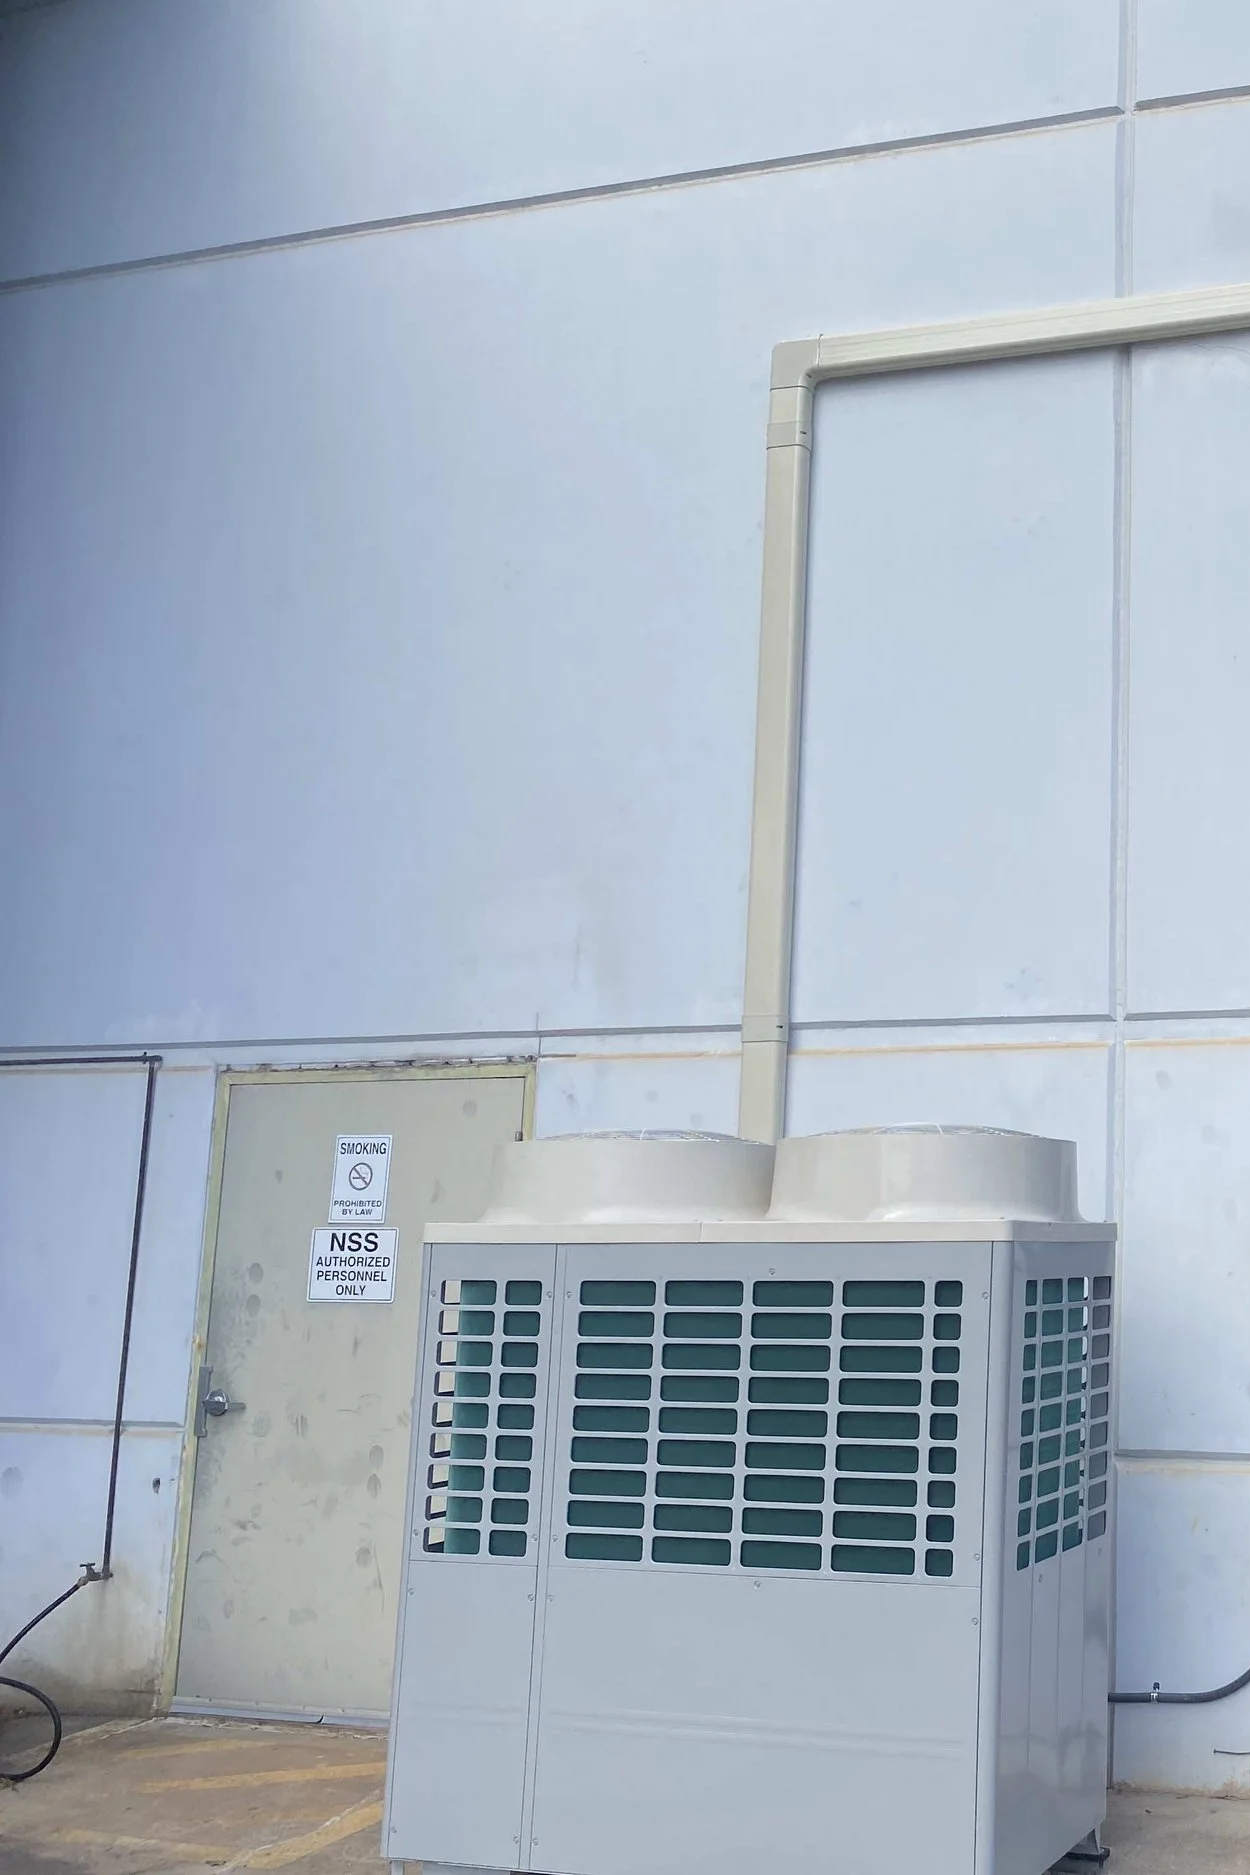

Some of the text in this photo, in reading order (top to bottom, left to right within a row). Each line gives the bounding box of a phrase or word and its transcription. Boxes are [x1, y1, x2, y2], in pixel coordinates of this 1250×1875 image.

[340, 1142, 387, 1155] SMOKING
[333, 1200, 382, 1208] PROHIBITED
[330, 1232, 379, 1252] NSS
[316, 1256, 391, 1268] AUTHORIZED
[316, 1270, 387, 1282] PERSONNEL
[335, 1284, 366, 1296] ONLY
